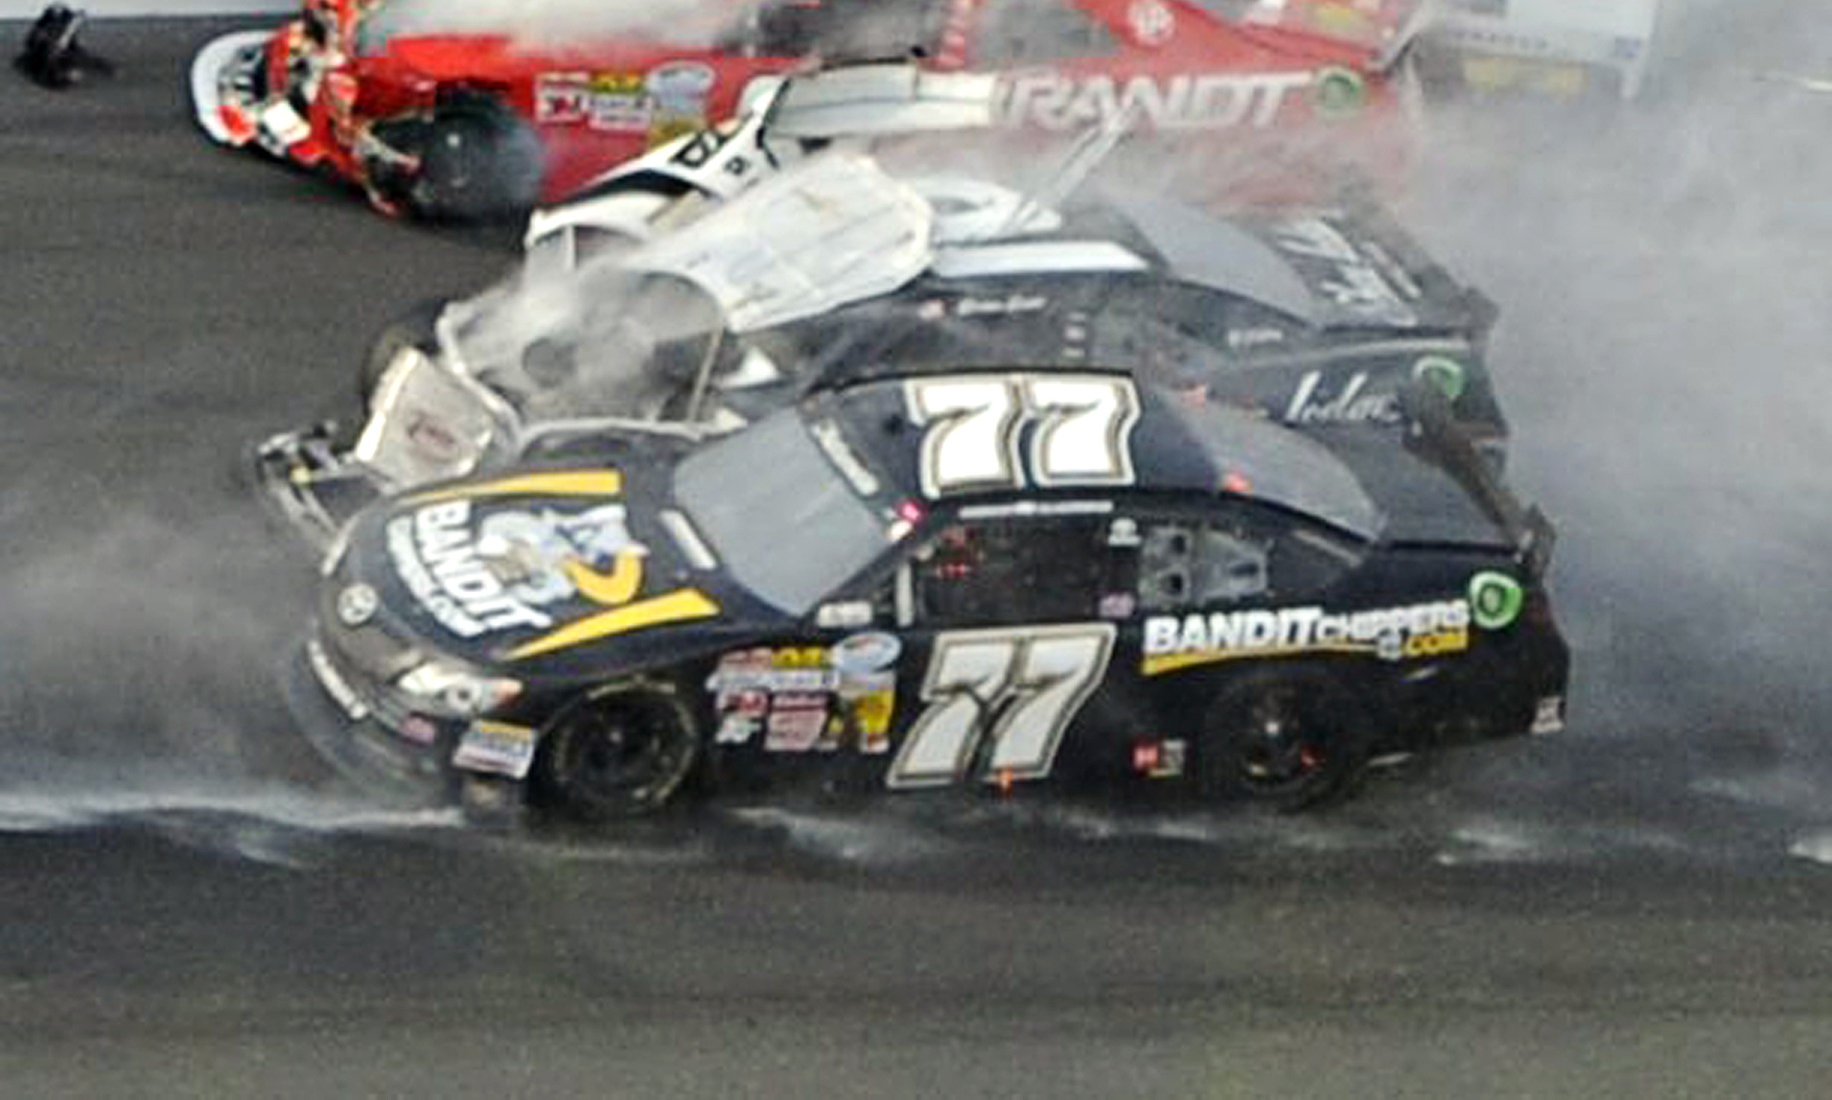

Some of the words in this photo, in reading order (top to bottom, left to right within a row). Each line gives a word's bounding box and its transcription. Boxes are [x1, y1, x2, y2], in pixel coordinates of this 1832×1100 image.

[990, 72, 1314, 132] RANDT
[903, 372, 1142, 498] 77
[416, 502, 551, 628] BANDIT
[887, 624, 1118, 790] 77
